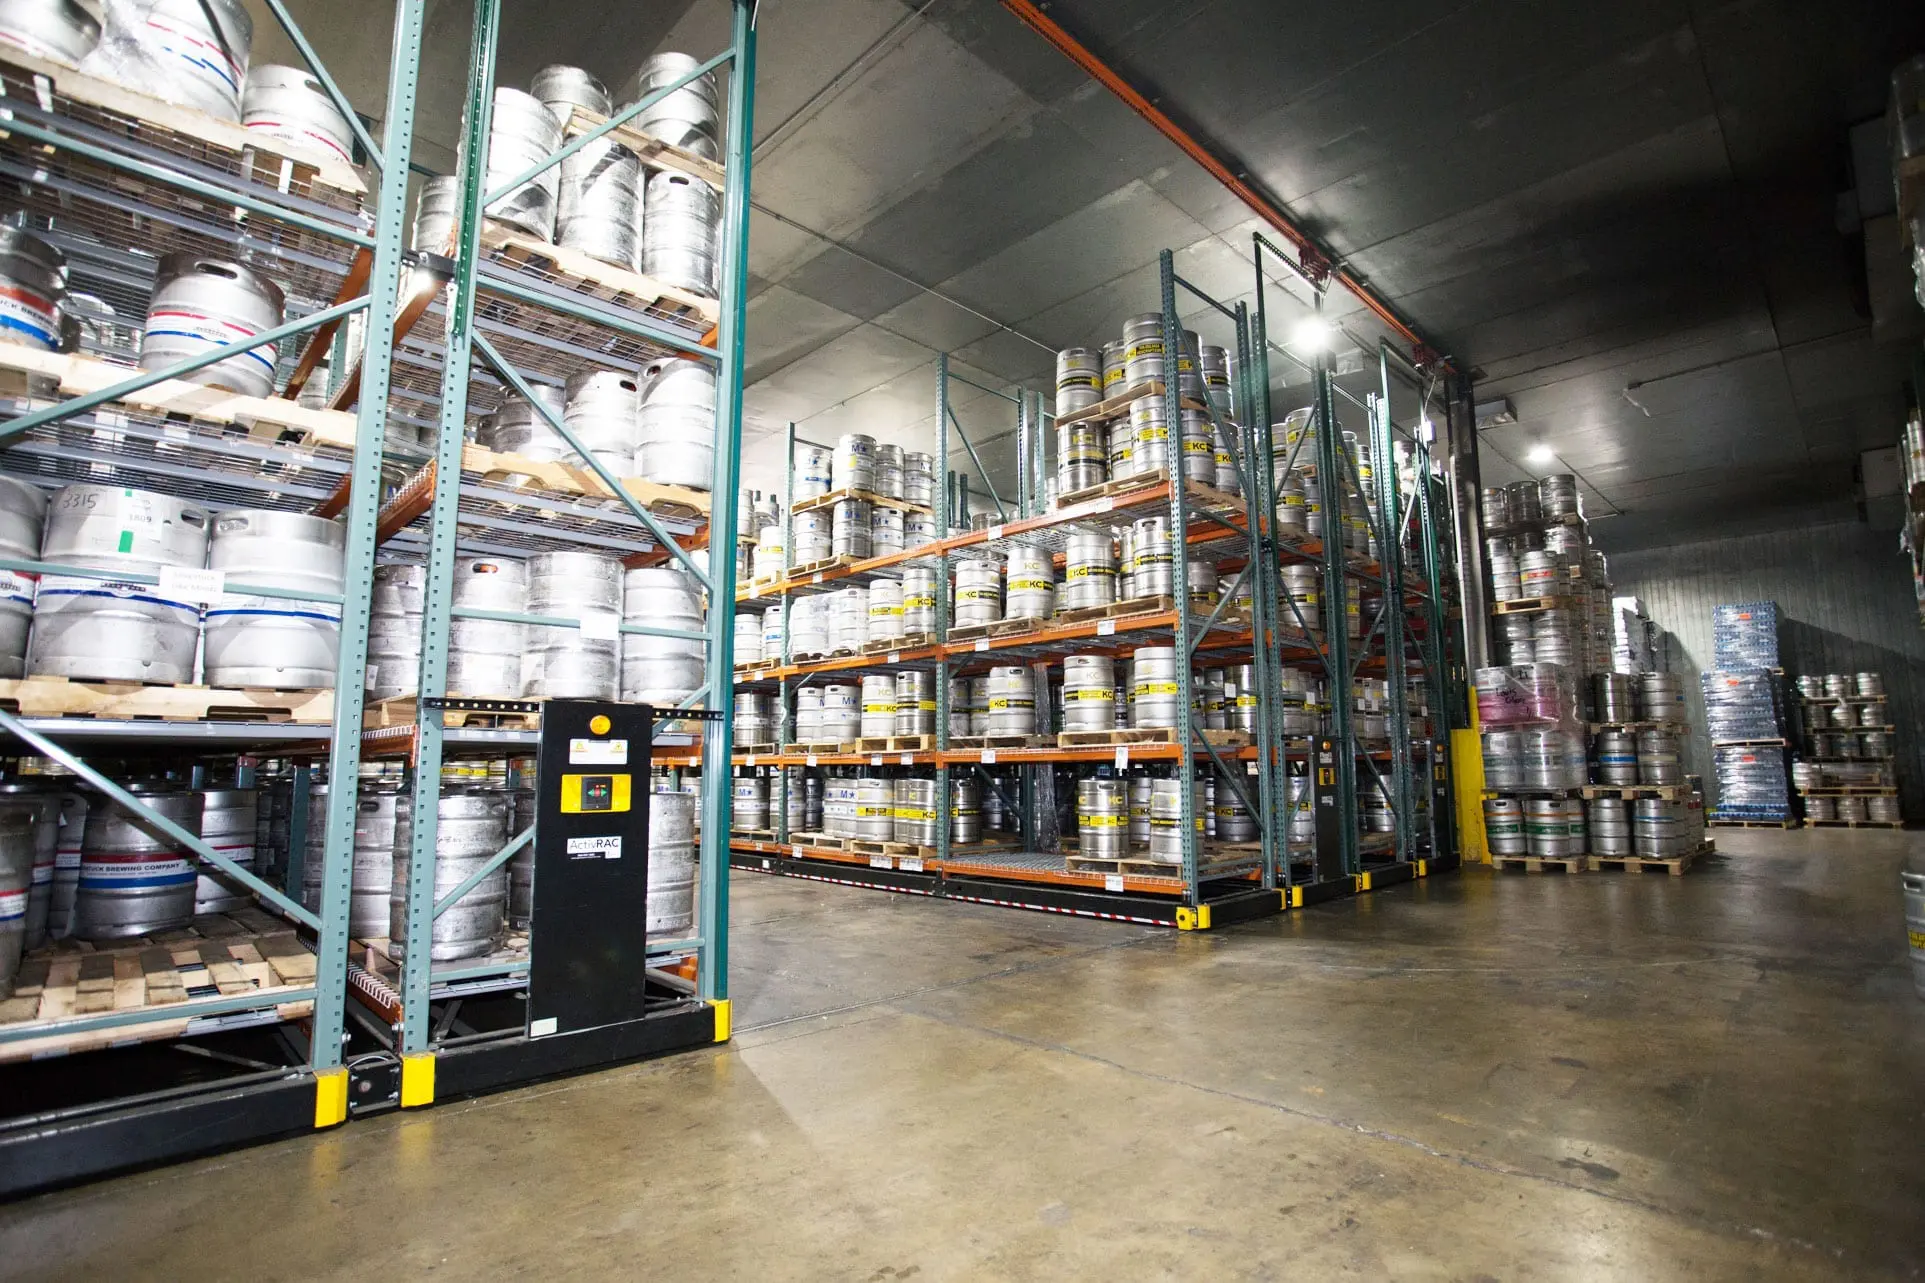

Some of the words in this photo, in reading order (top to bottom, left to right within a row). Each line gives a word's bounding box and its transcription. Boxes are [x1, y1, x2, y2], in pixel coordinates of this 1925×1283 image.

[63, 493, 99, 509] 3315
[1102, 691, 1113, 699] KC
[842, 697, 851, 705] M
[739, 789, 747, 797] M
[840, 790, 848, 798] M
[1078, 796, 1087, 804] C
[1108, 796, 1123, 804] KC
[923, 811, 936, 819] KC
[570, 838, 619, 850] ActivRAC
[105, 864, 142, 872] BREWING
[144, 863, 180, 871] COMPANY
